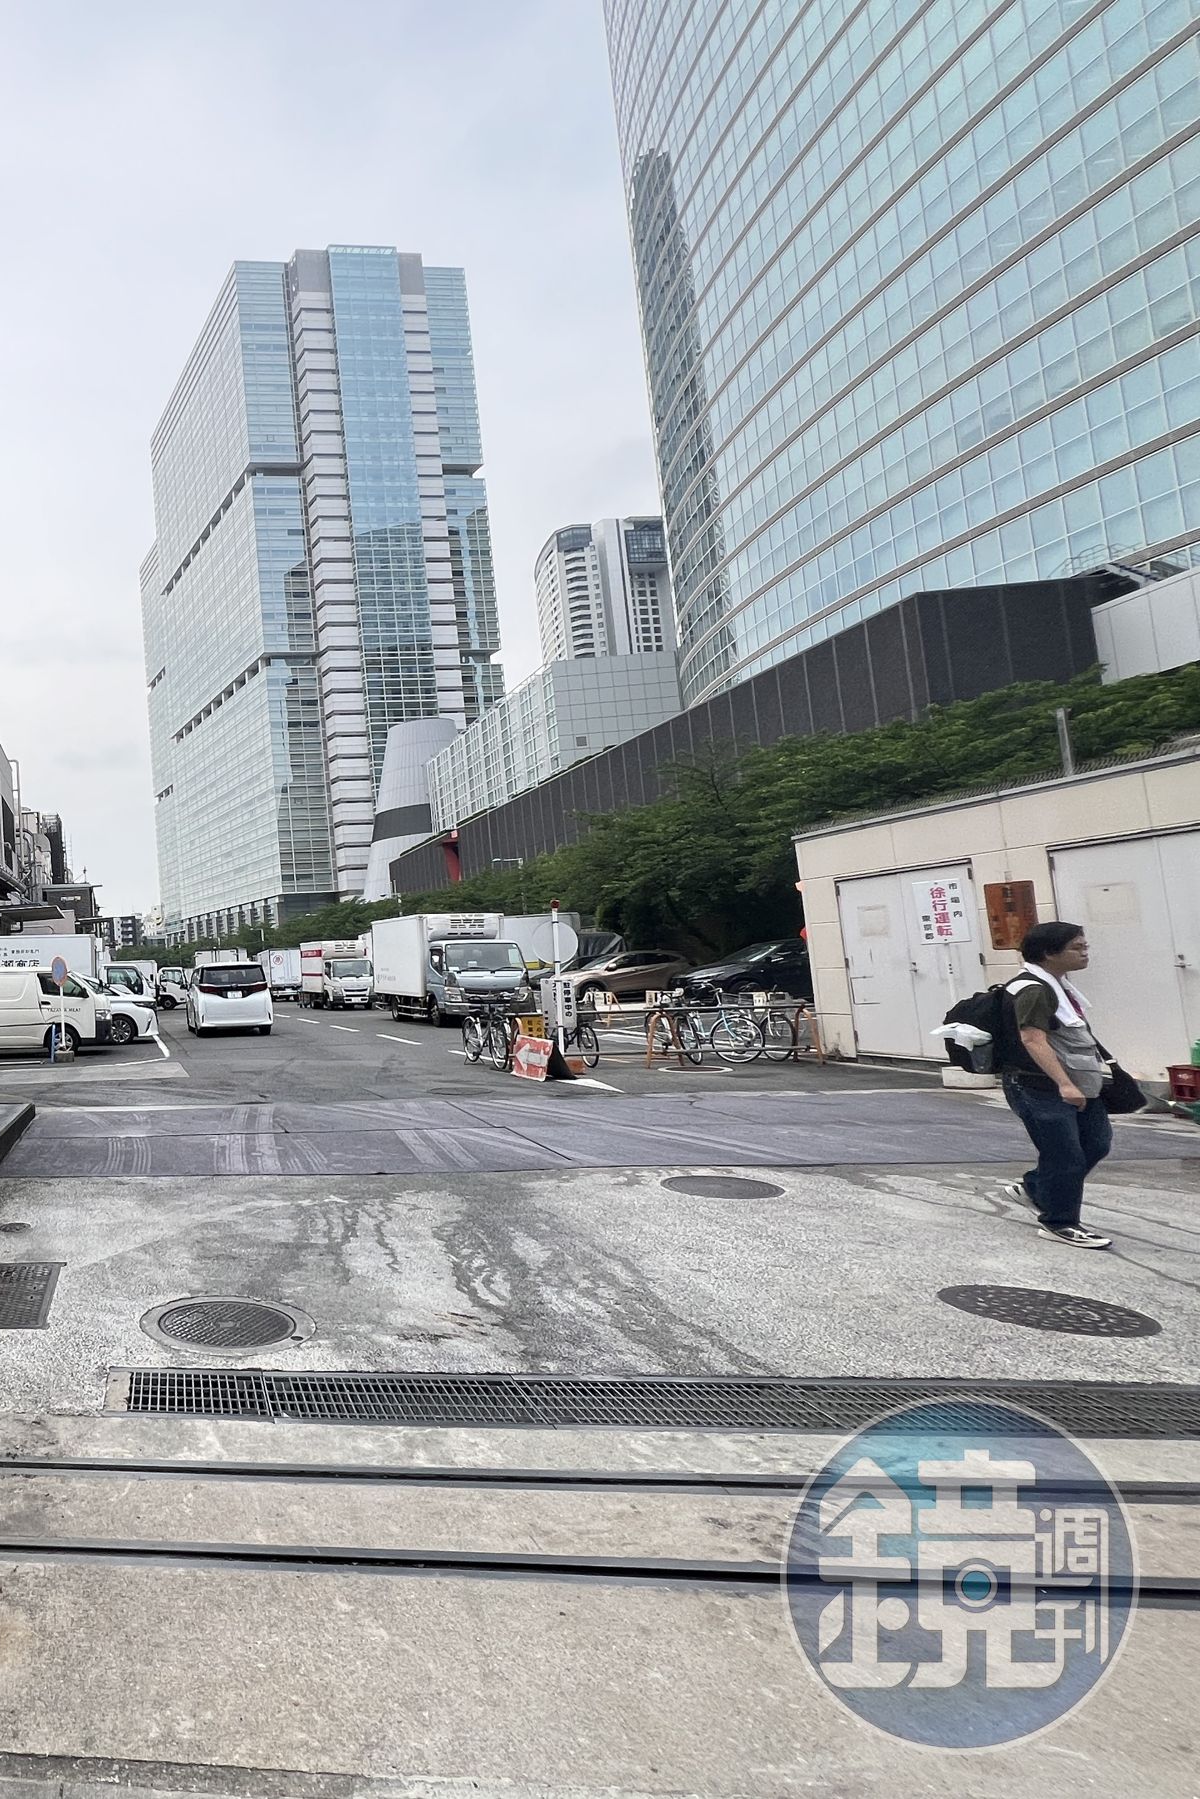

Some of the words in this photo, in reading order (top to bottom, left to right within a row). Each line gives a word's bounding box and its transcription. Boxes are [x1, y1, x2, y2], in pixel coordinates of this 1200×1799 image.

[930, 887, 953, 937] 徐行運転
[948, 883, 963, 918] 市場内
[922, 915, 934, 940] 東京都
[564, 982, 572, 1017] 駐停車中の
